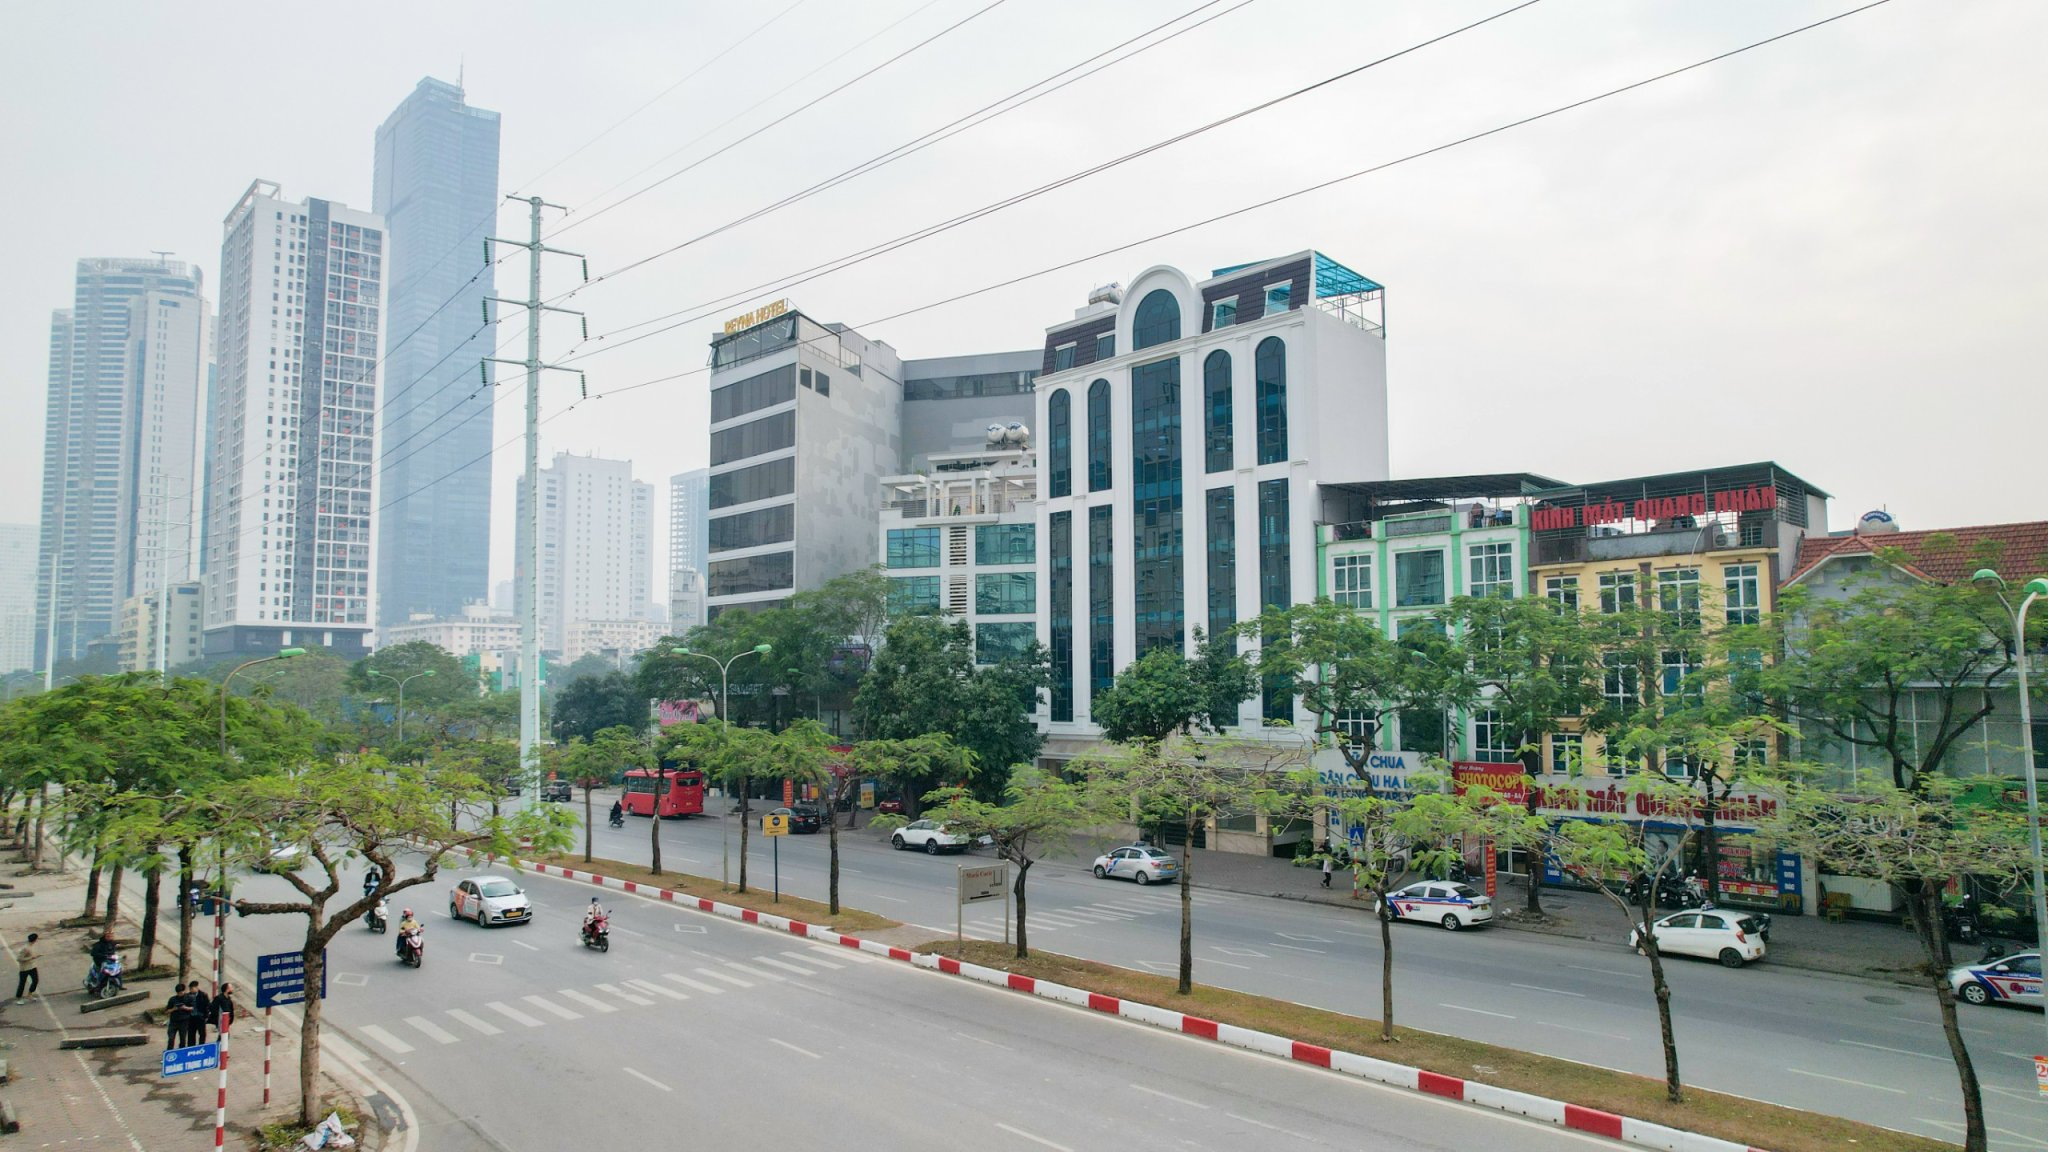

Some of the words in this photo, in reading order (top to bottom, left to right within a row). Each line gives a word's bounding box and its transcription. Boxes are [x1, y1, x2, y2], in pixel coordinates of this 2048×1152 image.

[724, 311, 755, 336] REYNA
[755, 299, 788, 324] HOTEL
[1582, 496, 1625, 526] MẮT
[1634, 493, 1705, 521] QUANG
[1714, 484, 1776, 513] NHÃN
[1459, 772, 1525, 790] PHOTOCOP
[187, 1046, 206, 1057] PHỐ
